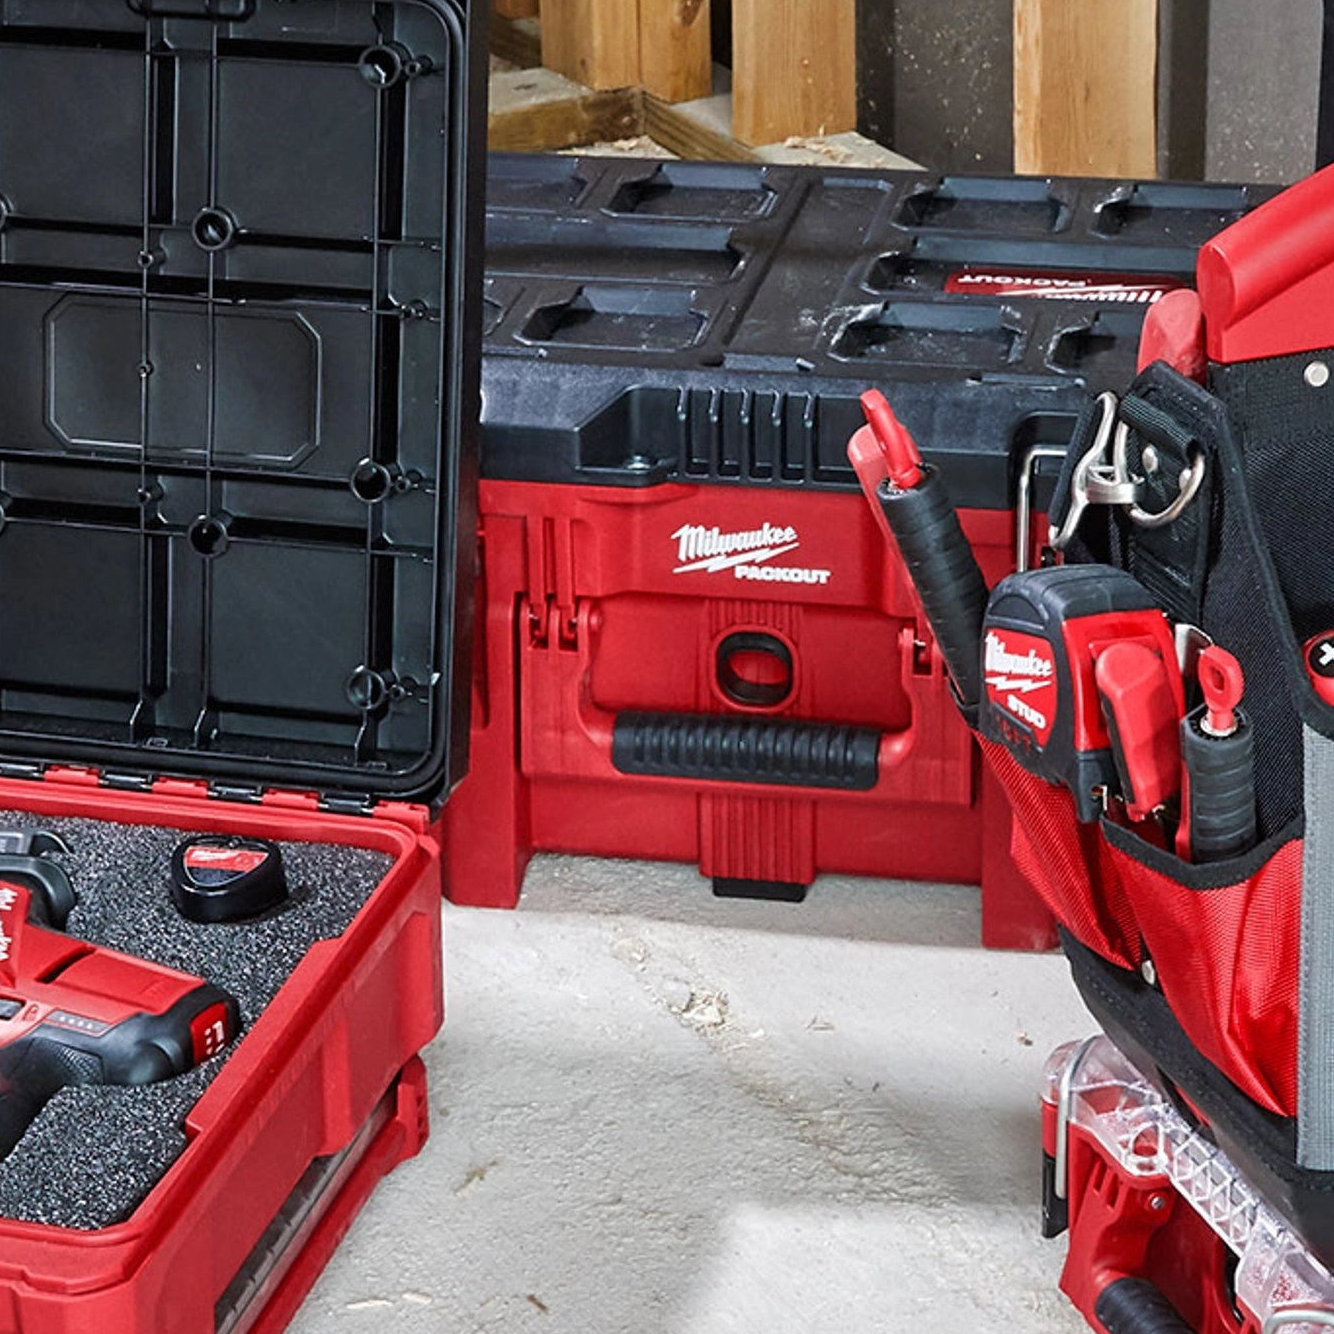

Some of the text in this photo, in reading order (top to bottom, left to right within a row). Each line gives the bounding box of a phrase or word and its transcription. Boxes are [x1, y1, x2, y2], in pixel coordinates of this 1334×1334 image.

[958, 274, 1086, 287] PACKOUT
[671, 522, 798, 562] Milwaukee
[734, 565, 831, 584] PACKOUT
[1007, 694, 1046, 730] STUD
